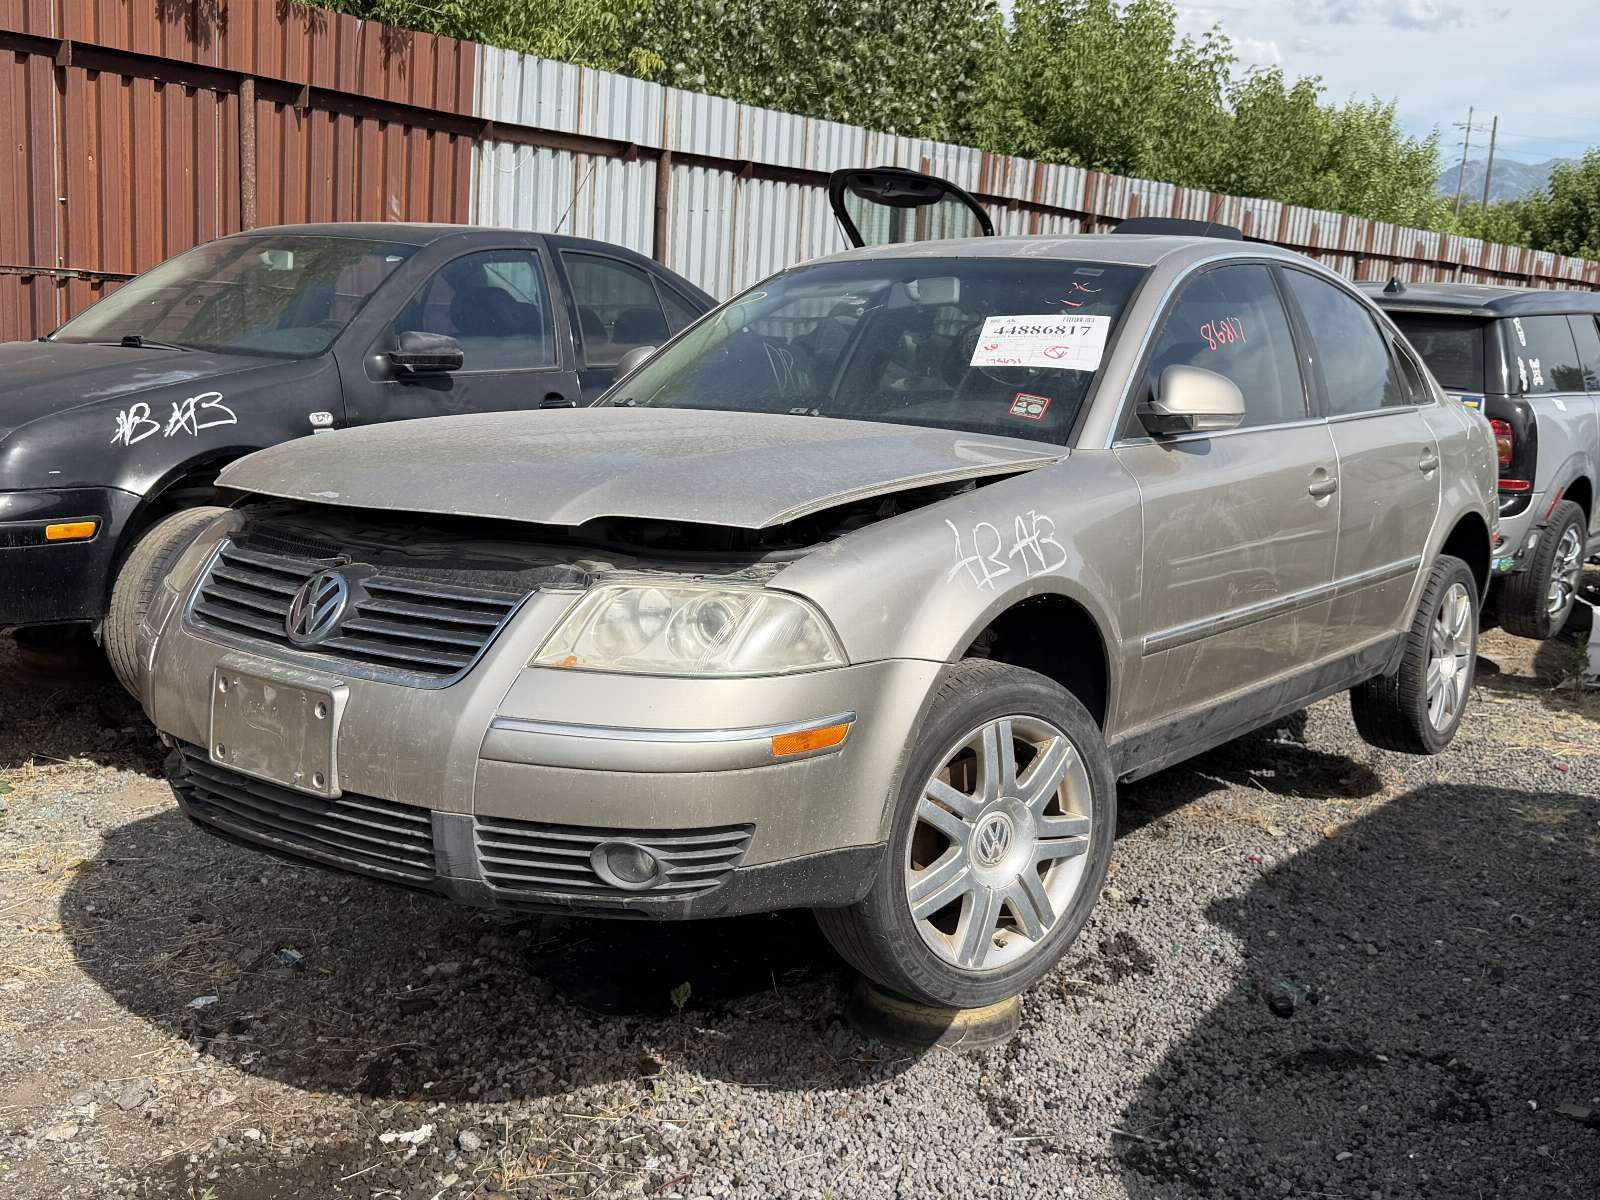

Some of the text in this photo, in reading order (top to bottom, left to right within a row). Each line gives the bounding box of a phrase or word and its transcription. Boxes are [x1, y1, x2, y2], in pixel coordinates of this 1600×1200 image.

[993, 325, 1092, 337] 44886817
[288, 573, 346, 640] VW
[978, 816, 1011, 862] VW
